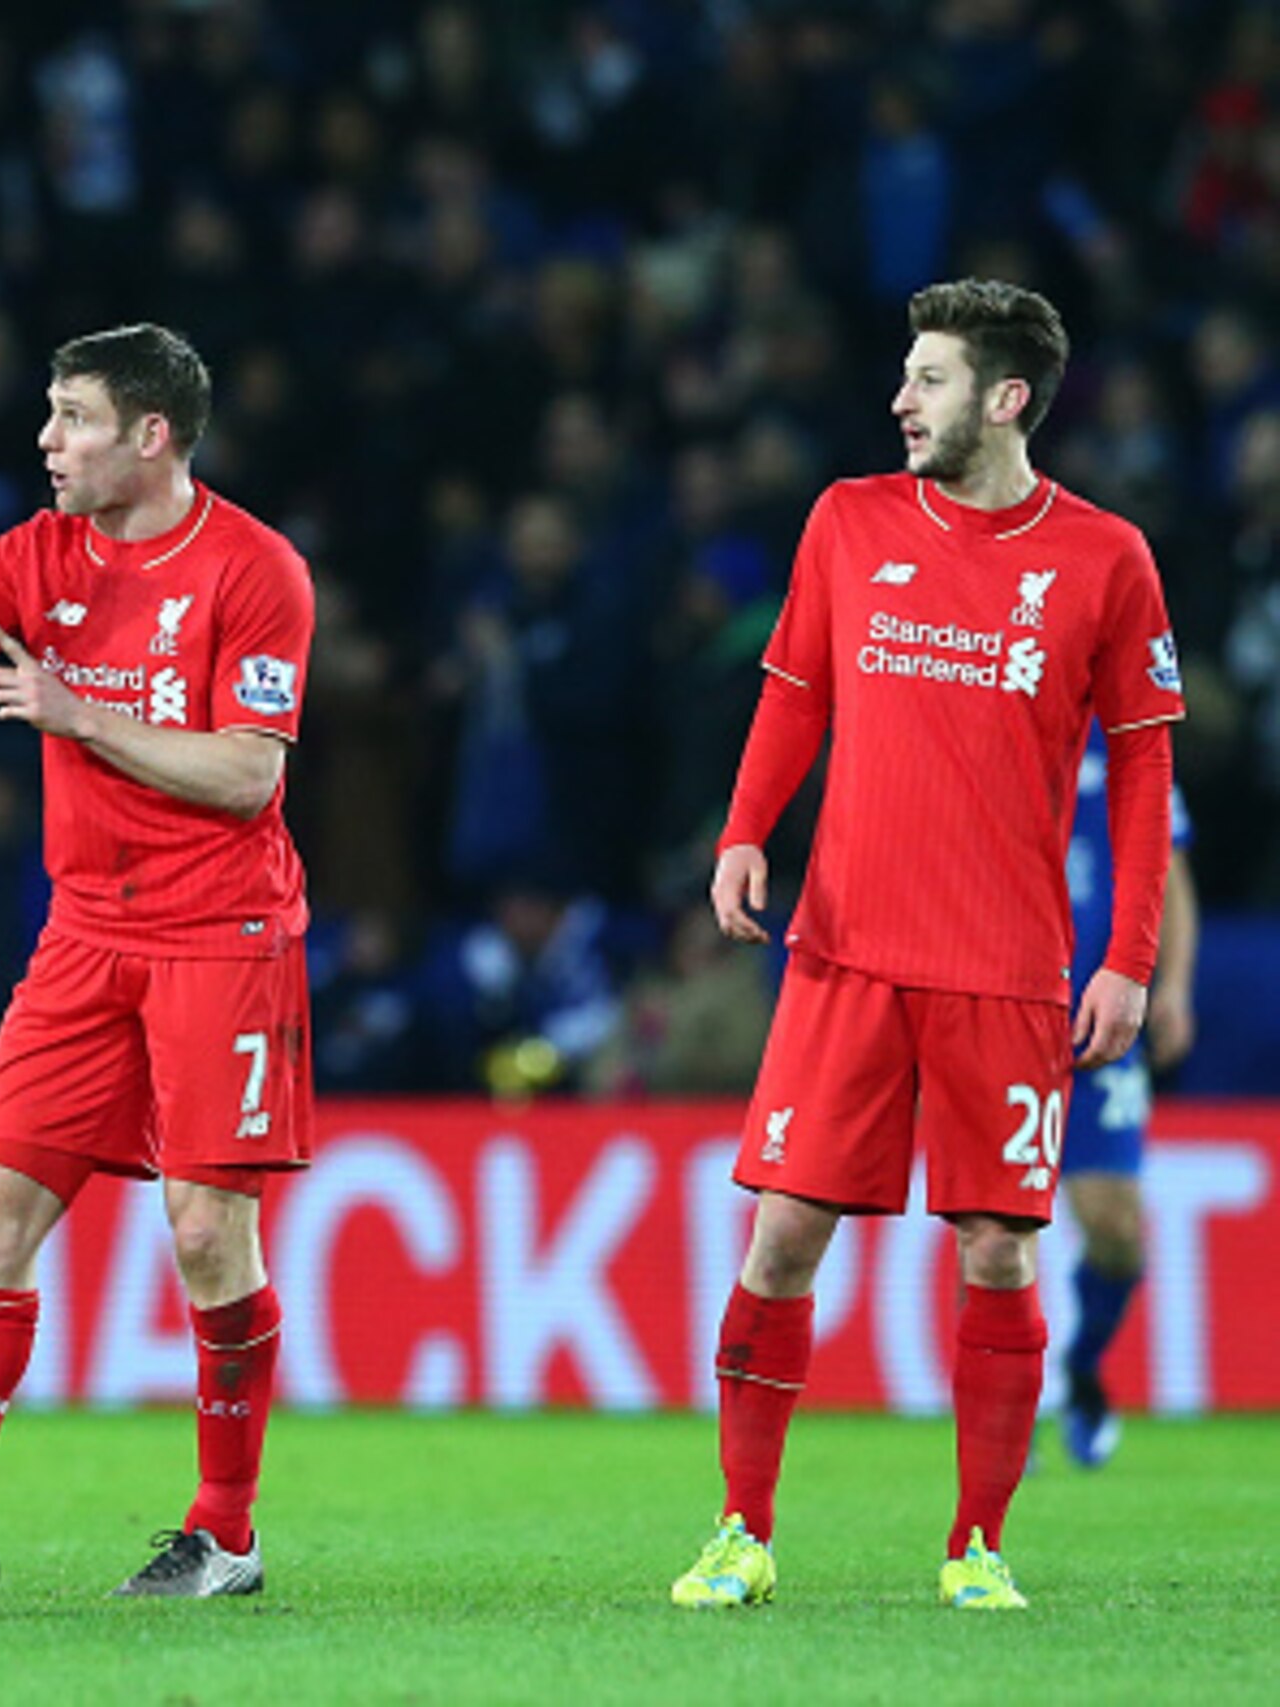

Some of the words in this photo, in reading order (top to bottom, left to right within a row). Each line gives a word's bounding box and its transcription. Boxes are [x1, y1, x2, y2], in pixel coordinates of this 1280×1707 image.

[856, 644, 998, 688] Chartered
[868, 611, 1003, 657] Standard
[232, 1031, 268, 1113] 7
[1002, 1083, 1062, 1168] 20
